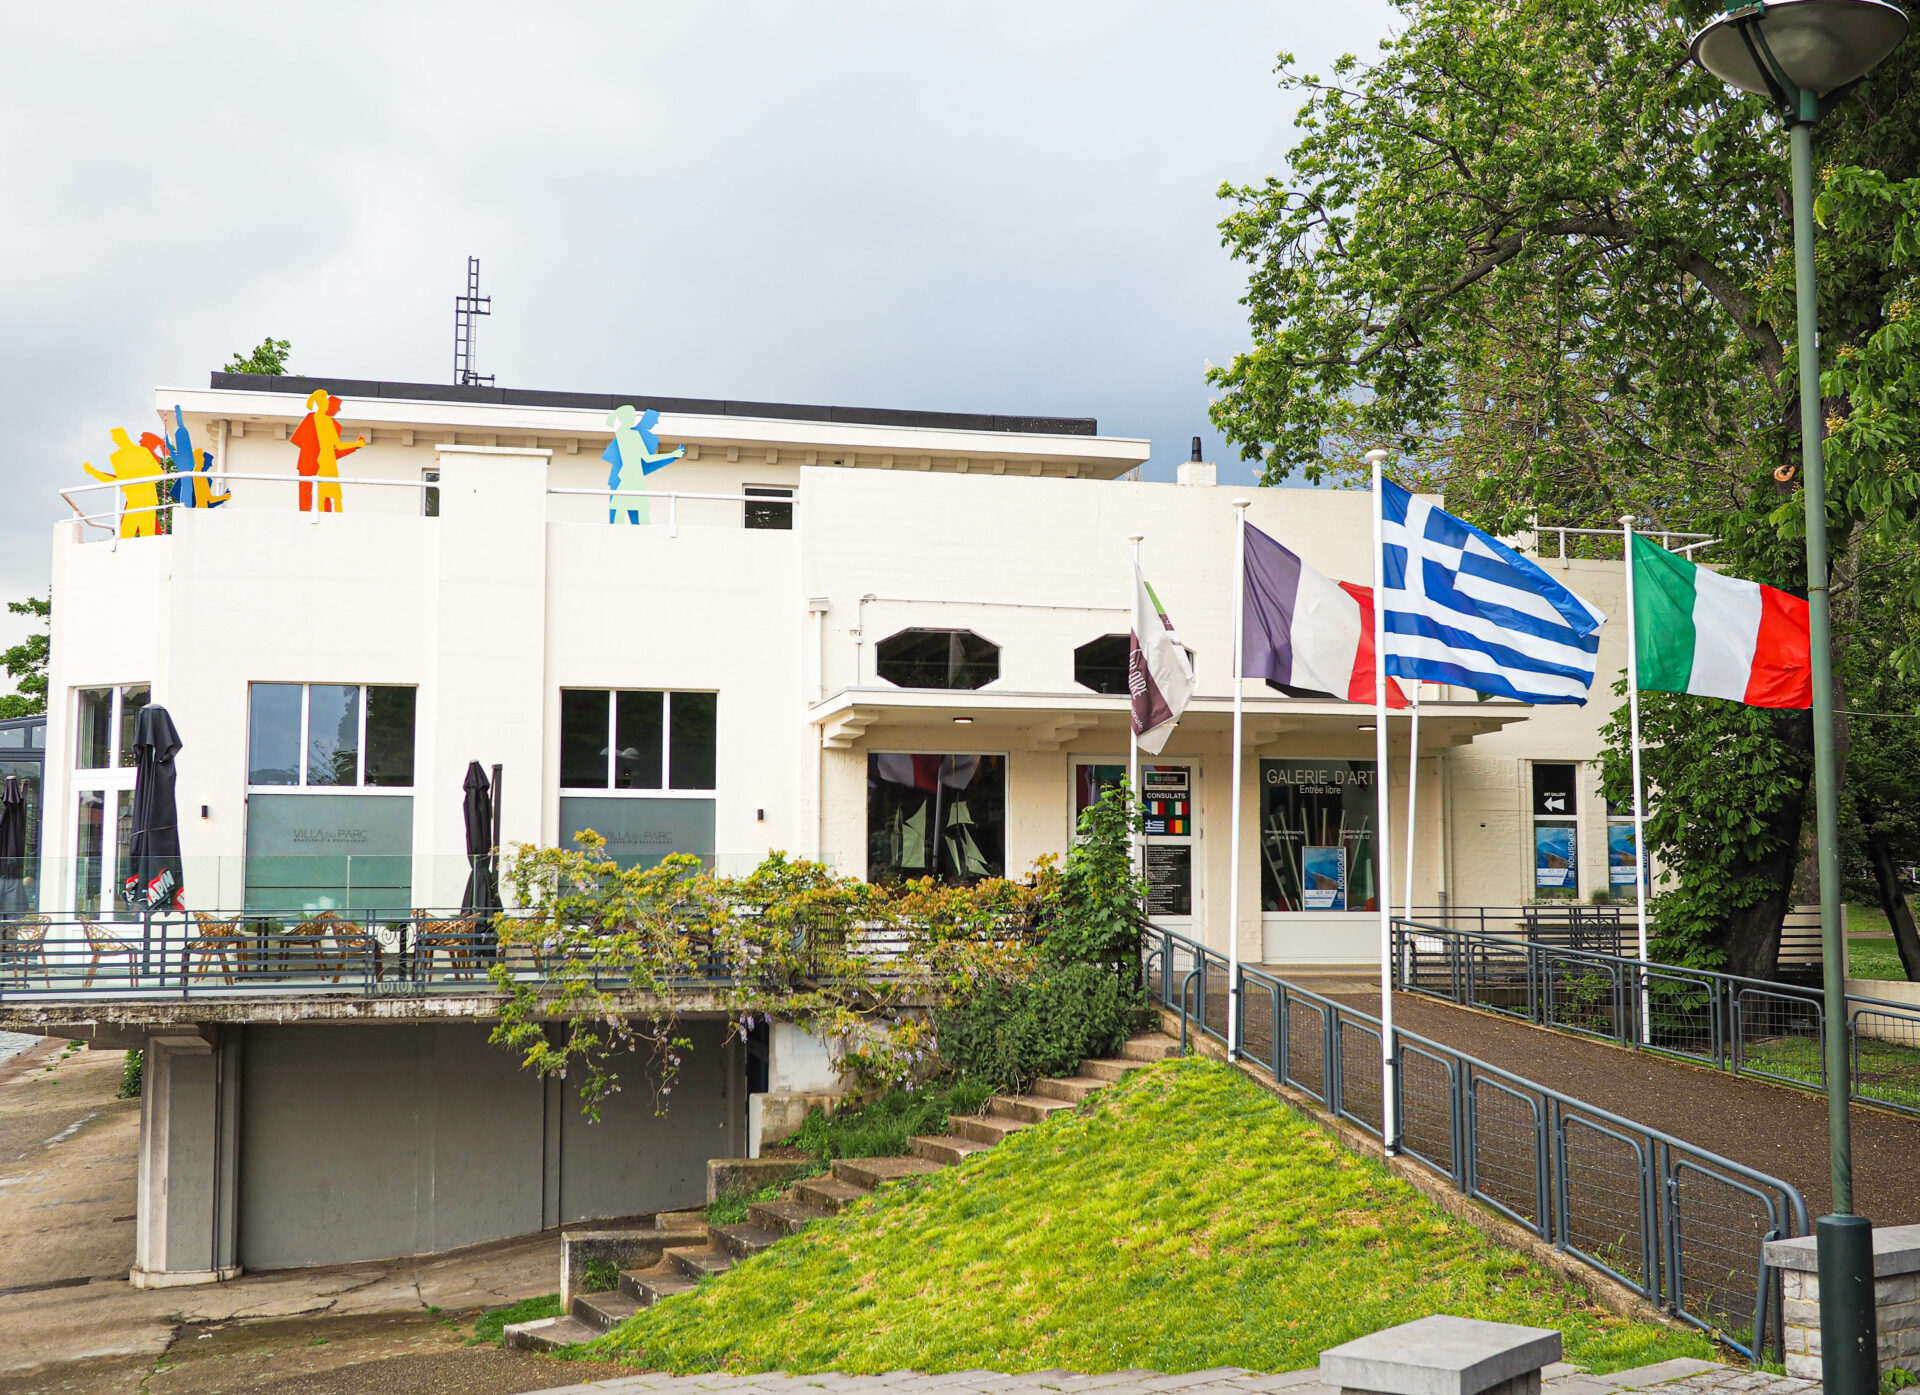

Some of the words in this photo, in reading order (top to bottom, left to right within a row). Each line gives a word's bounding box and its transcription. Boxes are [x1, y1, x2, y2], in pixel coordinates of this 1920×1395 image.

[1266, 769, 1328, 784] GALERIE
[1335, 770, 1376, 785] D'ART
[1325, 785, 1341, 794] libre
[293, 829, 323, 839] VILLA
[338, 829, 368, 839] PARC
[644, 831, 672, 841] PARC
